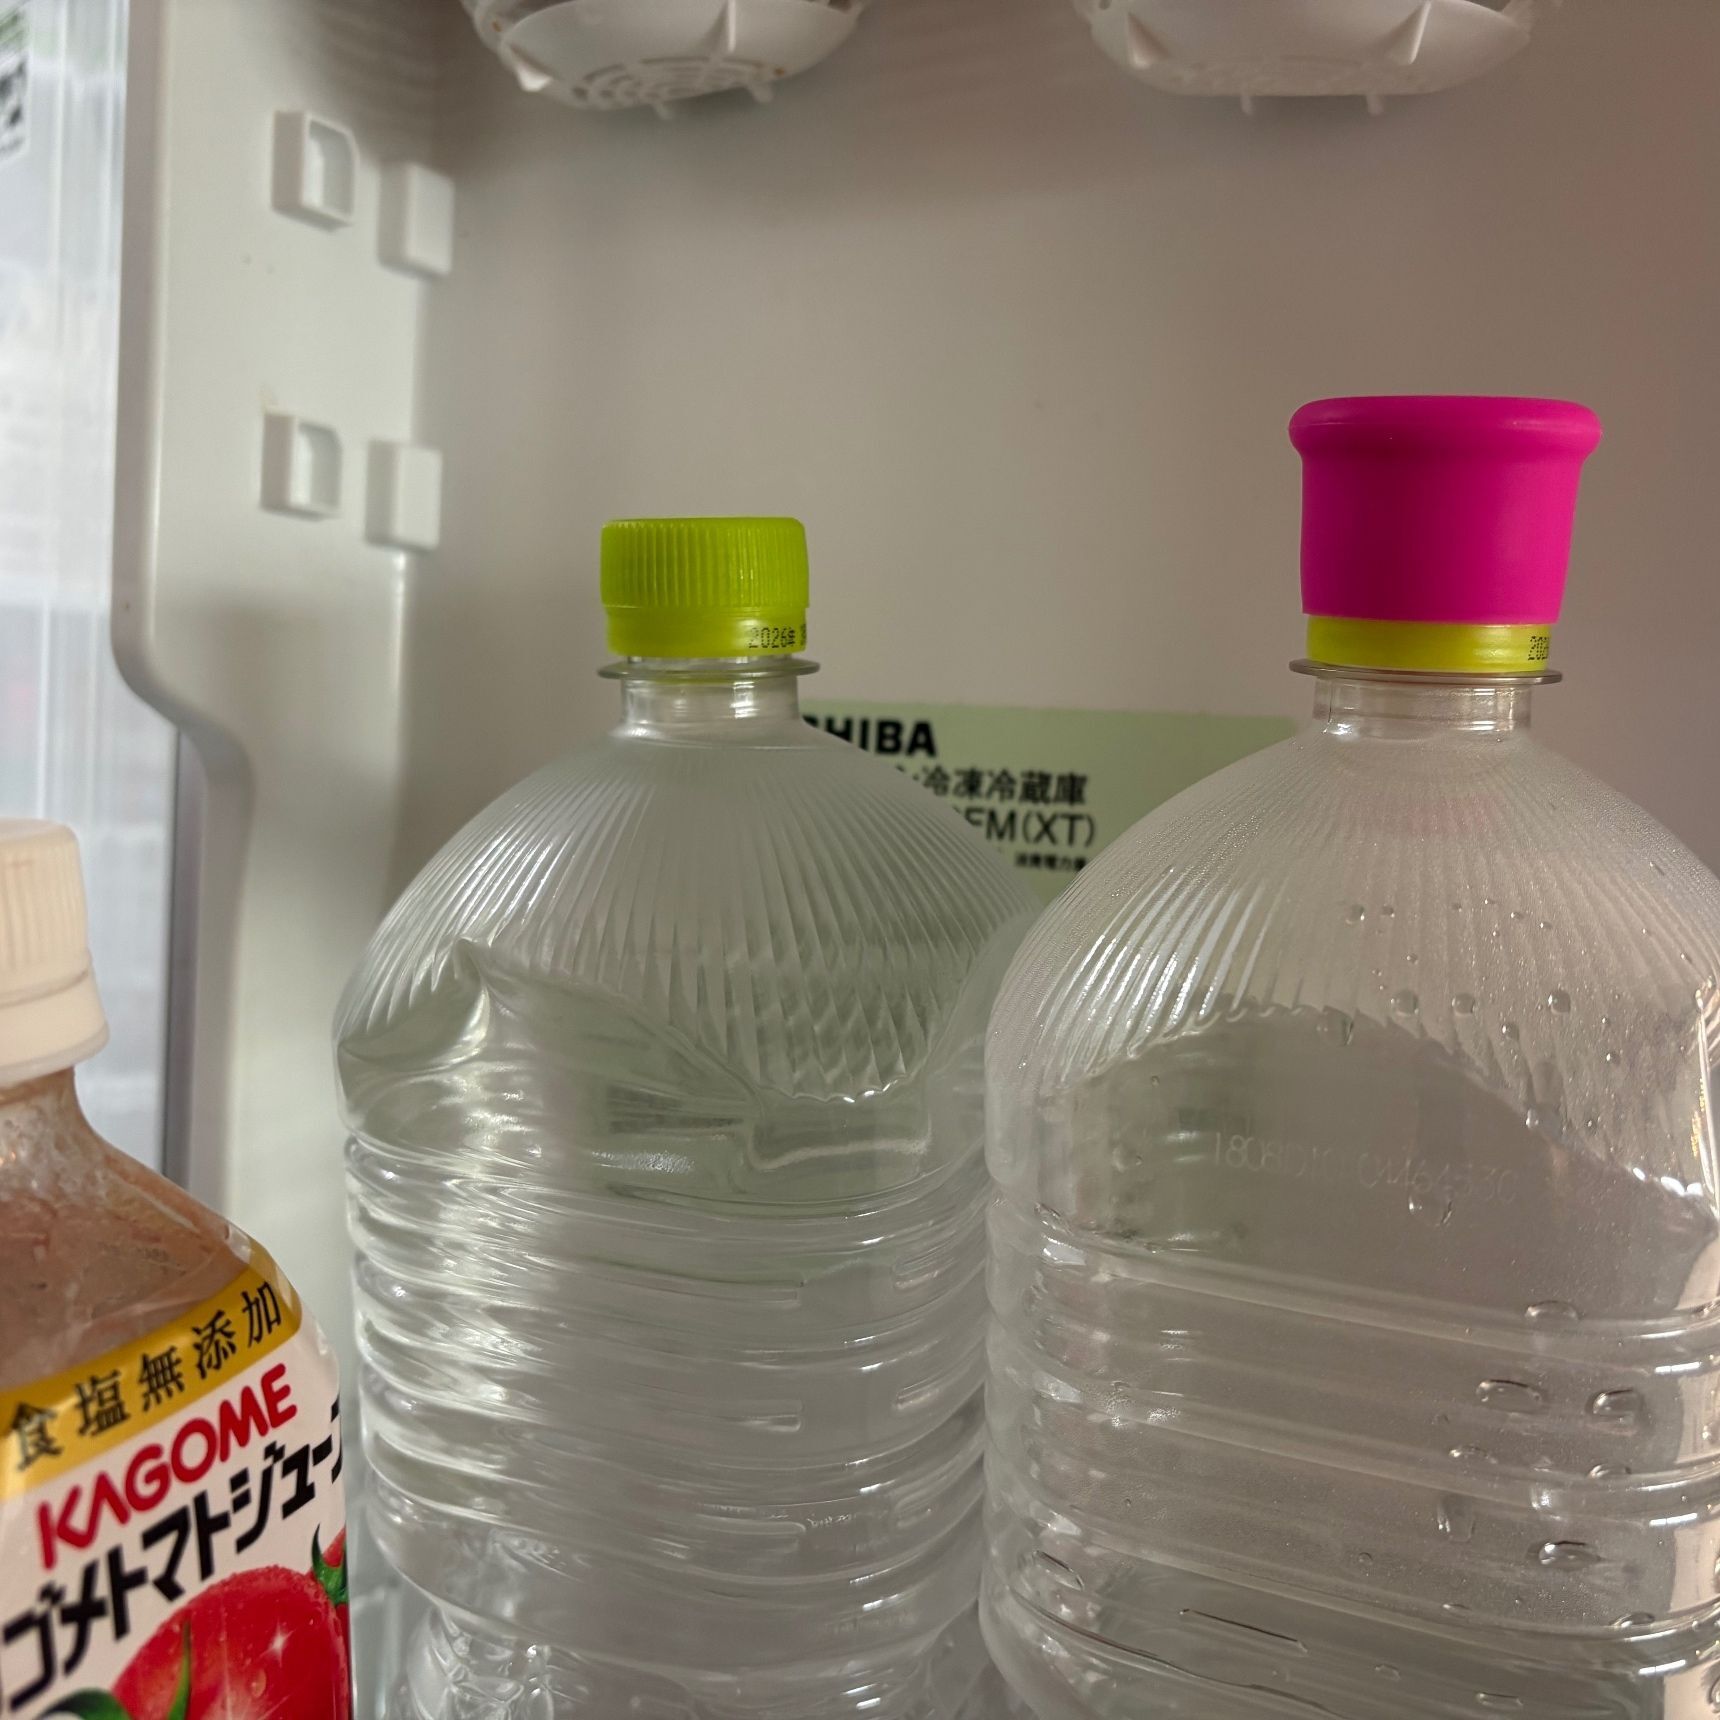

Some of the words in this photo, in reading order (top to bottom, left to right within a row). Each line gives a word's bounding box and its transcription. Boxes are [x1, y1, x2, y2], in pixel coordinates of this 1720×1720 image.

[802, 714, 937, 757] HIBA
[10, 1281, 283, 1471] 食塩無添加
[38, 1363, 298, 1570] KAGOME
